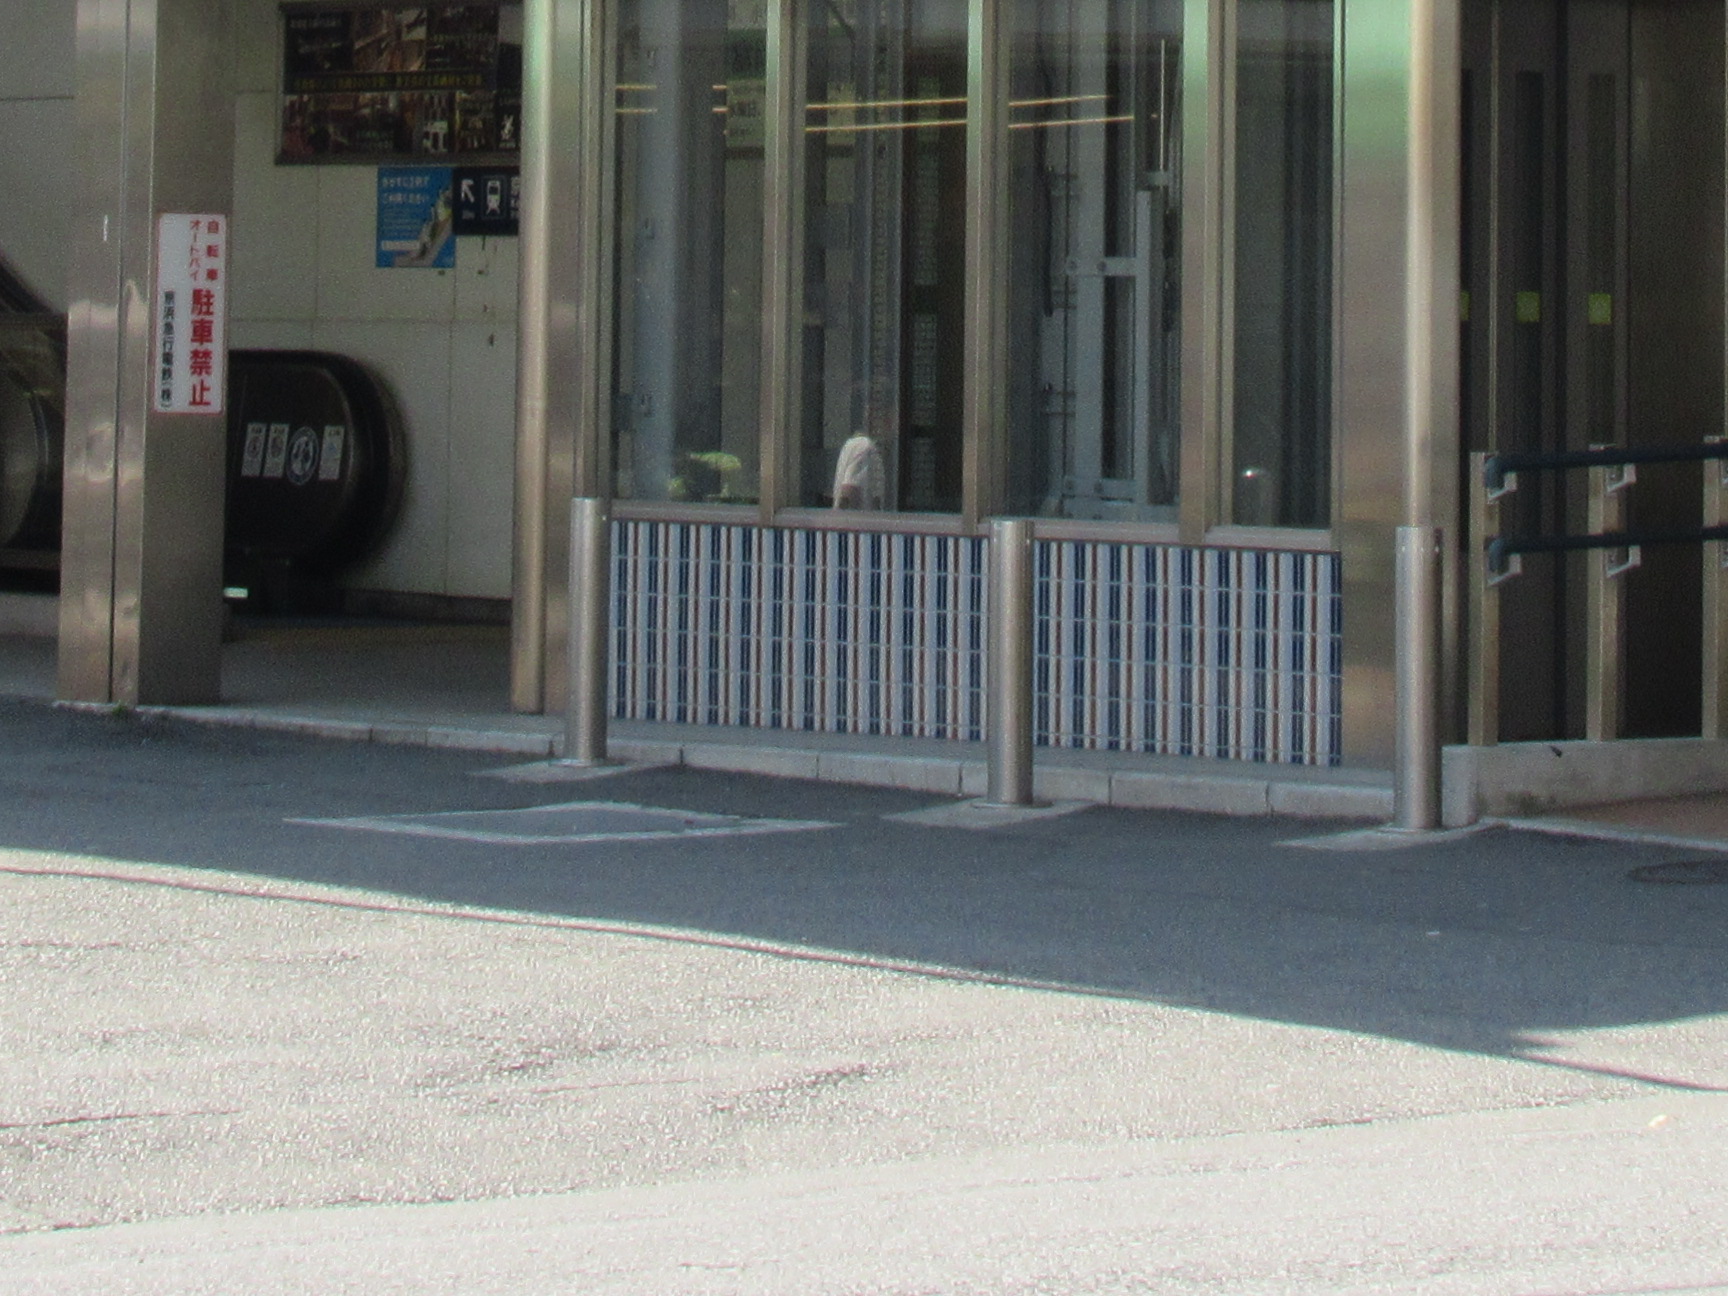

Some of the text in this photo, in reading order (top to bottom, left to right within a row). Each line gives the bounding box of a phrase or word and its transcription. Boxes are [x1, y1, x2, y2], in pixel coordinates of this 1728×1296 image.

[189, 218, 202, 282] オートバイ
[206, 219, 220, 281] 自転車
[189, 288, 215, 406] 駐車禁止
